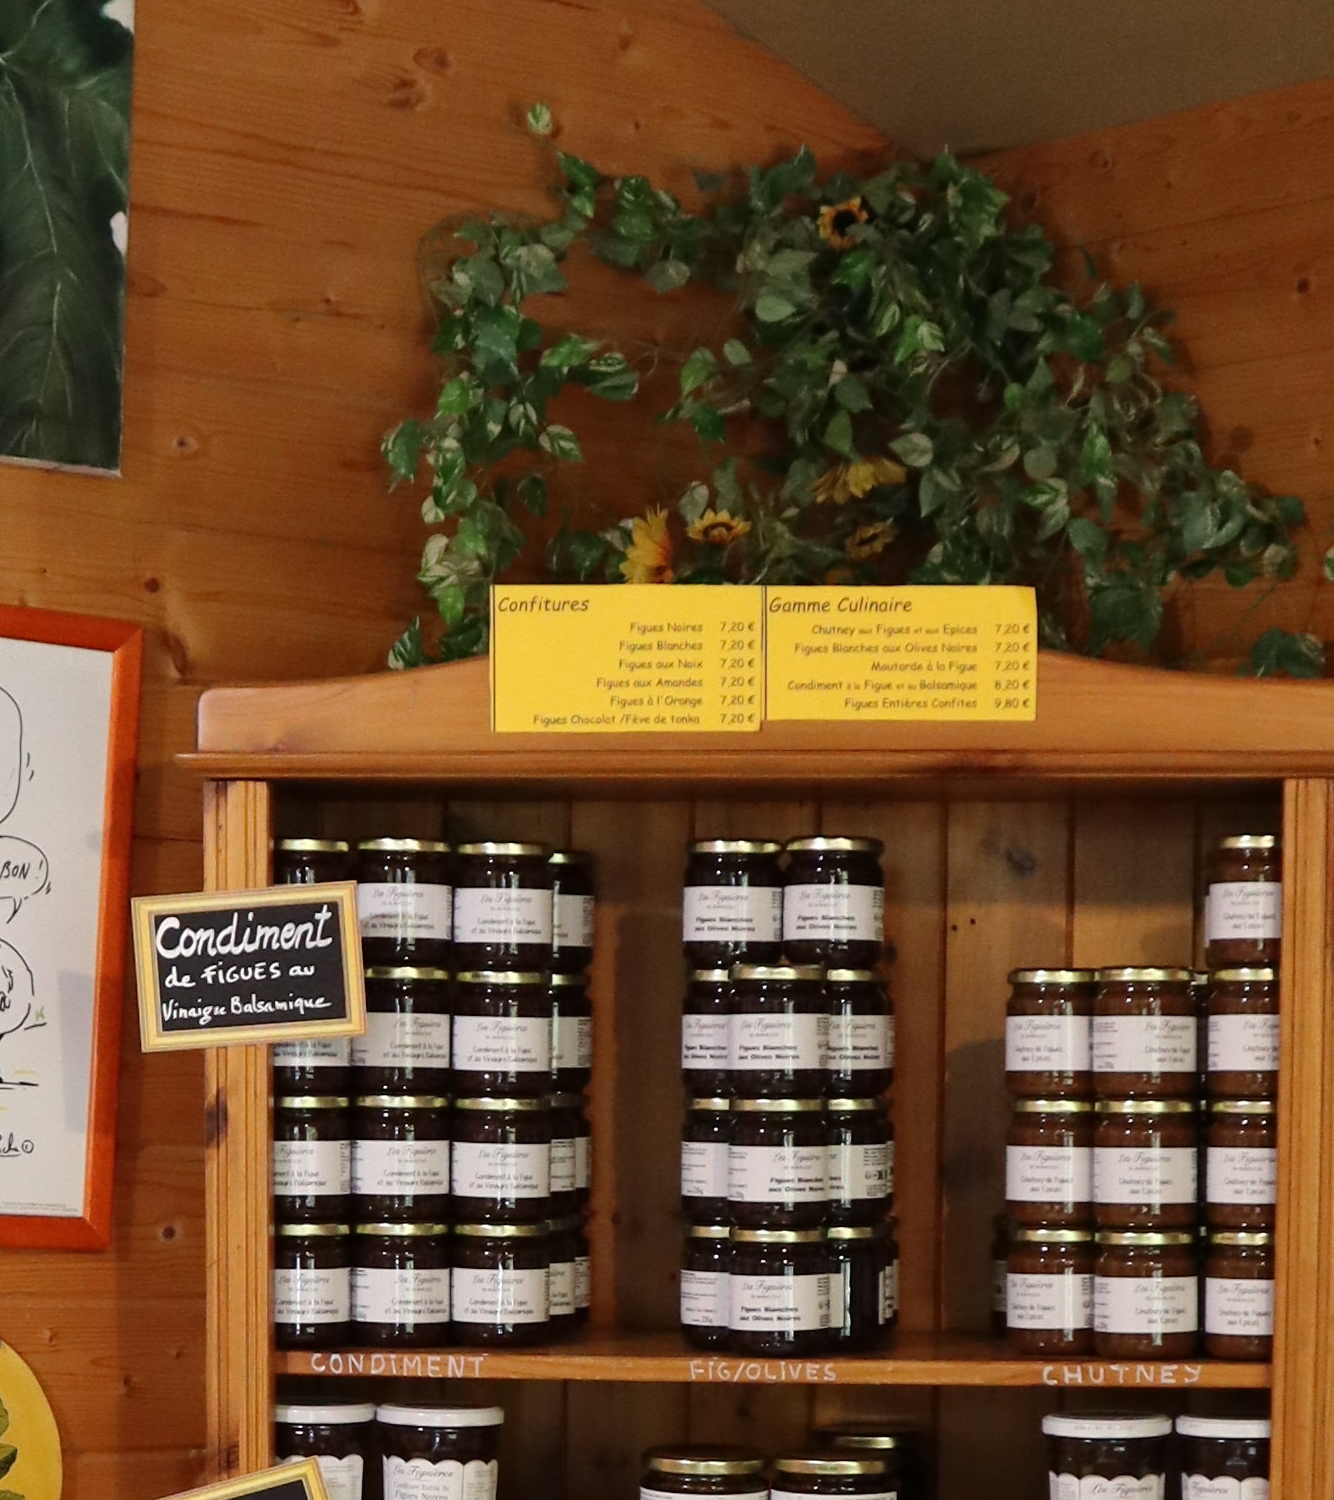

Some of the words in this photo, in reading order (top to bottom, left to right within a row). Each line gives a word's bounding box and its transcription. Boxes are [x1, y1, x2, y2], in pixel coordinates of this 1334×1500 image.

[498, 596, 590, 613] Confitures
[769, 597, 830, 613] Gamme
[837, 596, 913, 613] Culinaire
[156, 905, 333, 959] Condiment
[164, 966, 196, 988] de
[288, 963, 315, 977] au
[230, 992, 332, 1015] Balsamique
[1042, 1364, 1202, 1386] CHUTNEY
